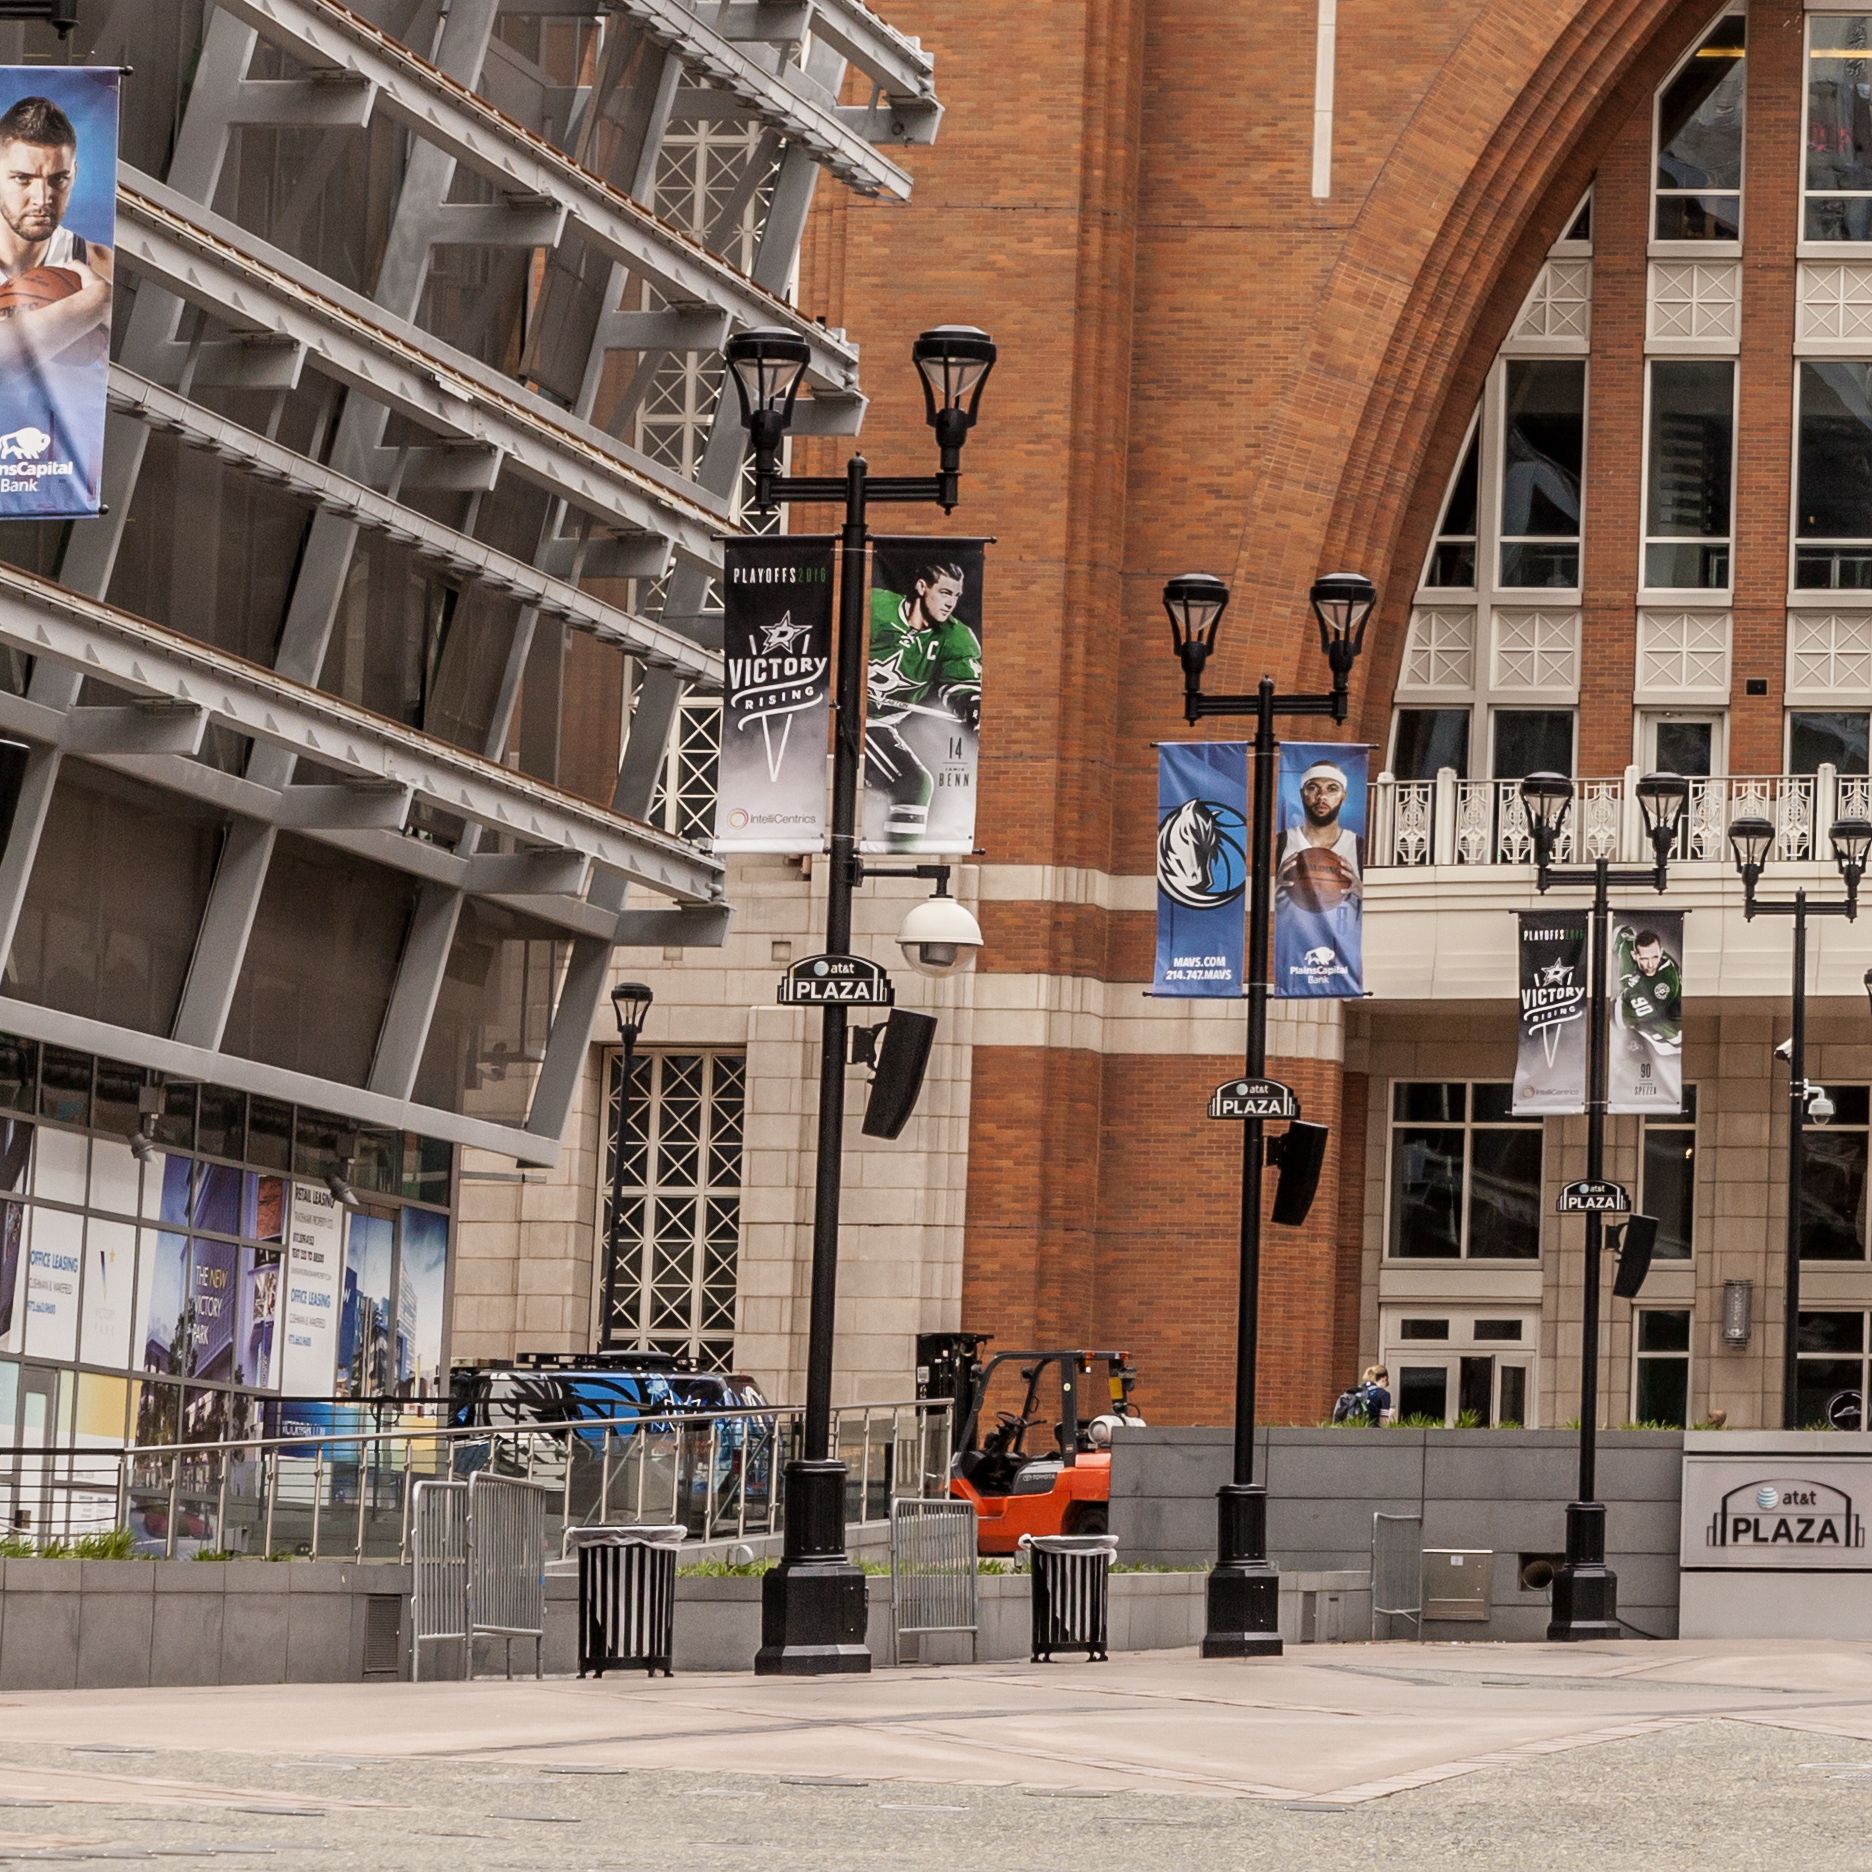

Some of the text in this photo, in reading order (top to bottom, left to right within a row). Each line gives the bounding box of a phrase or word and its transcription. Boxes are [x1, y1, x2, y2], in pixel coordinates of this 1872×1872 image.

[0, 478, 39, 492] Bank
[734, 568, 827, 584] PLAYOFFS2016
[729, 657, 827, 690] VICTORY
[745, 687, 815, 710] RISING
[949, 736, 963, 759] 14
[938, 773, 970, 787] BENN
[750, 814, 817, 825] IntelliCentrics
[830, 962, 855, 974] at&t
[1173, 956, 1226, 969] MAVS.COM
[1165, 969, 1232, 981] 214.747.MAVS
[1289, 966, 1349, 976] PlainsCapital
[1307, 976, 1330, 985] Bank
[796, 981, 870, 1000] PLAZA
[1521, 986, 1585, 1010] VICTORY
[1640, 1063, 1651, 1079] 90
[1249, 1085, 1269, 1094] at&t
[1222, 1100, 1282, 1114] PLAZA
[1568, 1197, 1615, 1209] PLAZA
[196, 1265, 229, 1290] THE NEW
[1782, 1490, 1817, 1506] at&t
[1732, 1517, 1840, 1544] PLAZA
